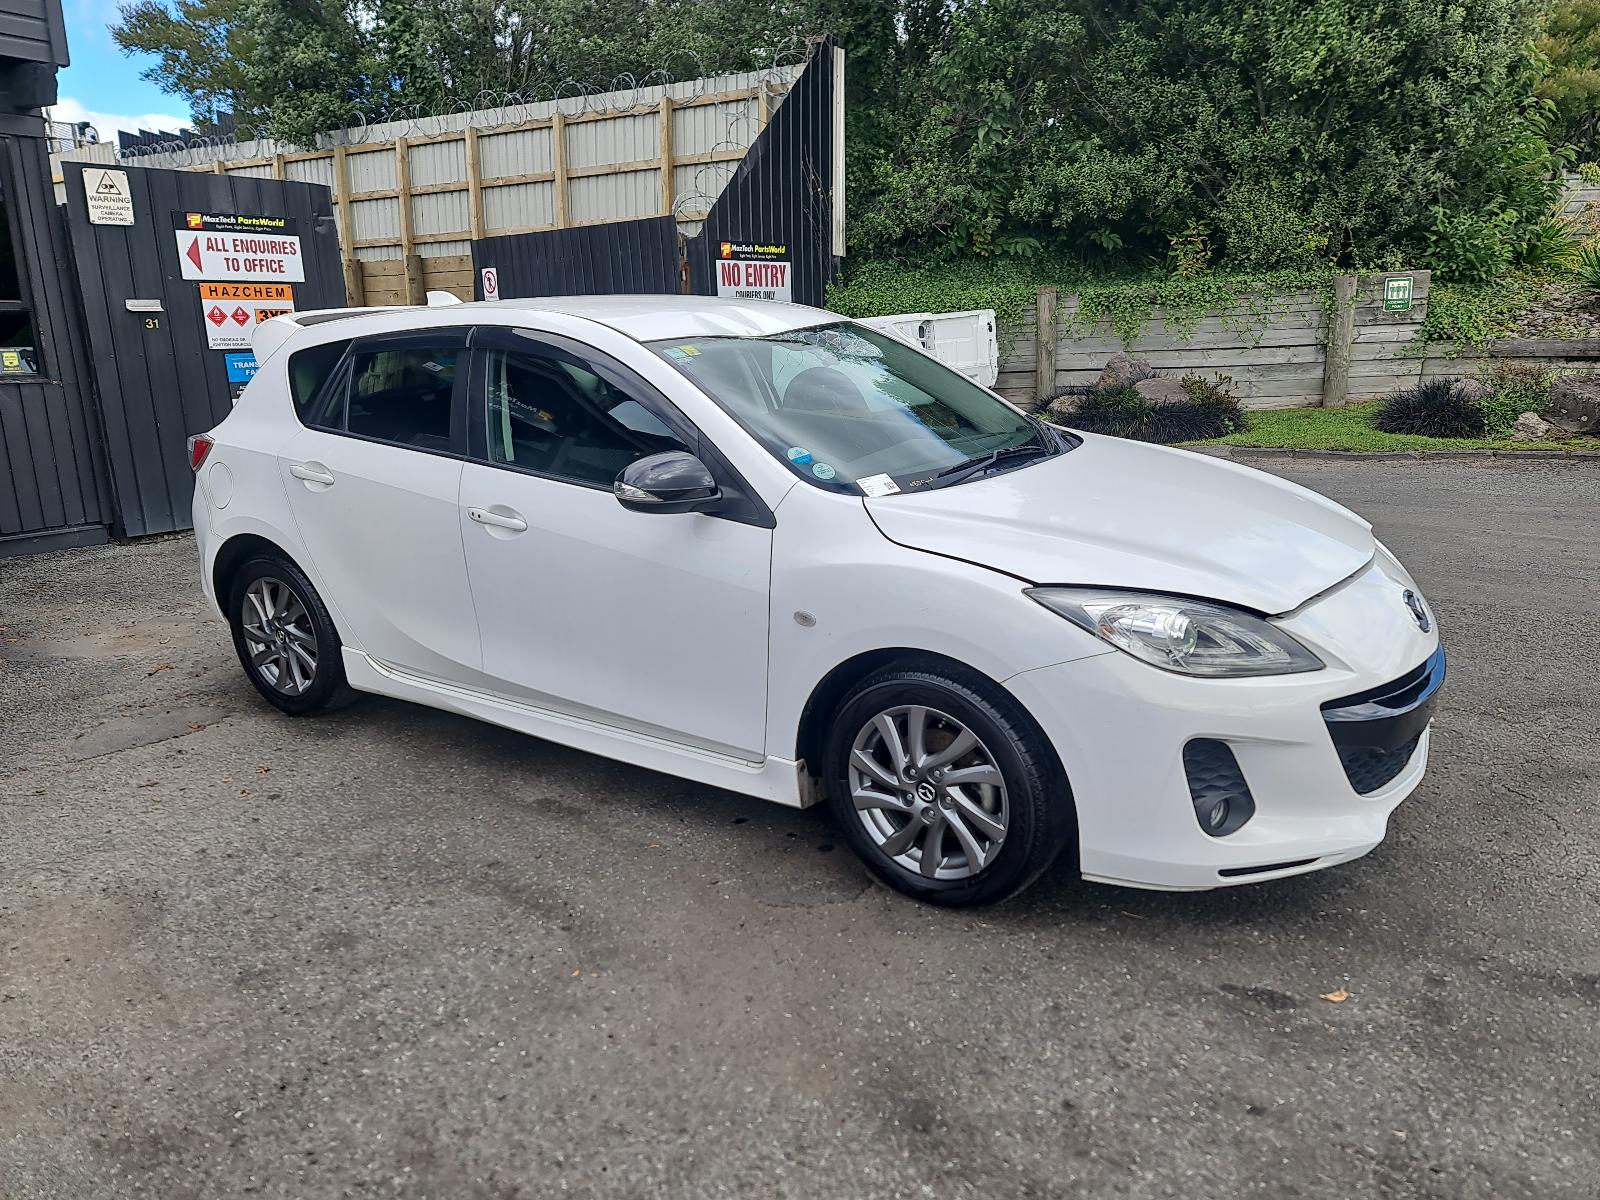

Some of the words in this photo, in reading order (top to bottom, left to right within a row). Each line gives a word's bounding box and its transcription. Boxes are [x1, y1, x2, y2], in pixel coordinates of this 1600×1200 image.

[89, 195, 130, 203] WARNING
[202, 214, 236, 224] MazTech
[237, 217, 284, 227] PartsWorld
[206, 237, 229, 253] ALL
[232, 238, 297, 256] ENQUIRIES
[732, 244, 754, 252] MazTech
[754, 245, 786, 254] PartsWorld
[224, 257, 240, 272] TO
[244, 258, 285, 274] OFFICE
[721, 262, 741, 287] NO
[745, 263, 786, 288] ENTRY
[208, 285, 286, 298] HAZCHEM
[762, 290, 776, 300] ONLY
[145, 319, 159, 329] 31
[233, 361, 260, 369] TRANS
